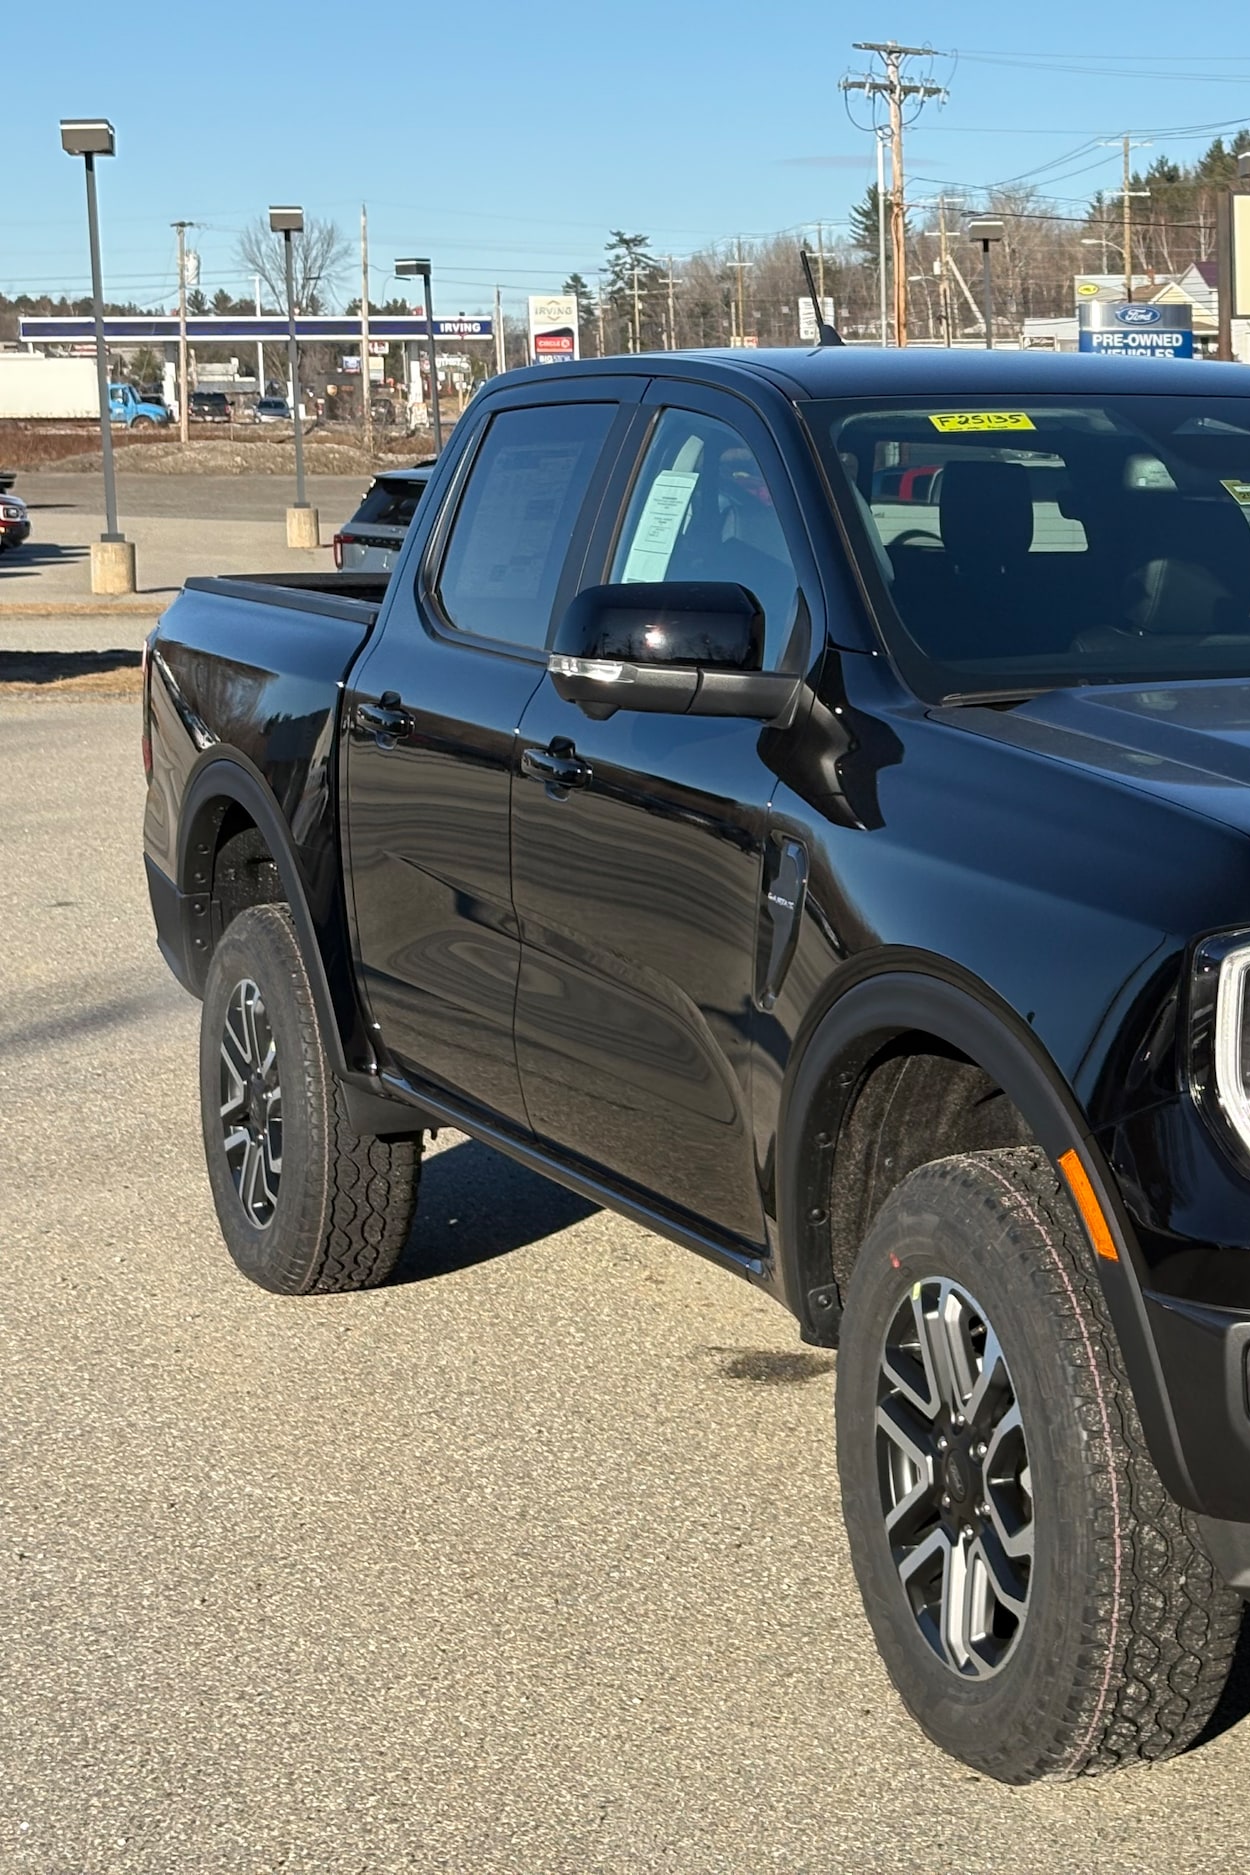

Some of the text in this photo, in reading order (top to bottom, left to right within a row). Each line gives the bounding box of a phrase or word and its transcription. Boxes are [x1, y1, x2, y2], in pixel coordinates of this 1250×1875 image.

[535, 306, 573, 315] IRVING
[1124, 308, 1153, 321] Ford
[440, 322, 482, 333] IRVING
[1092, 333, 1183, 347] PRE-OWNED
